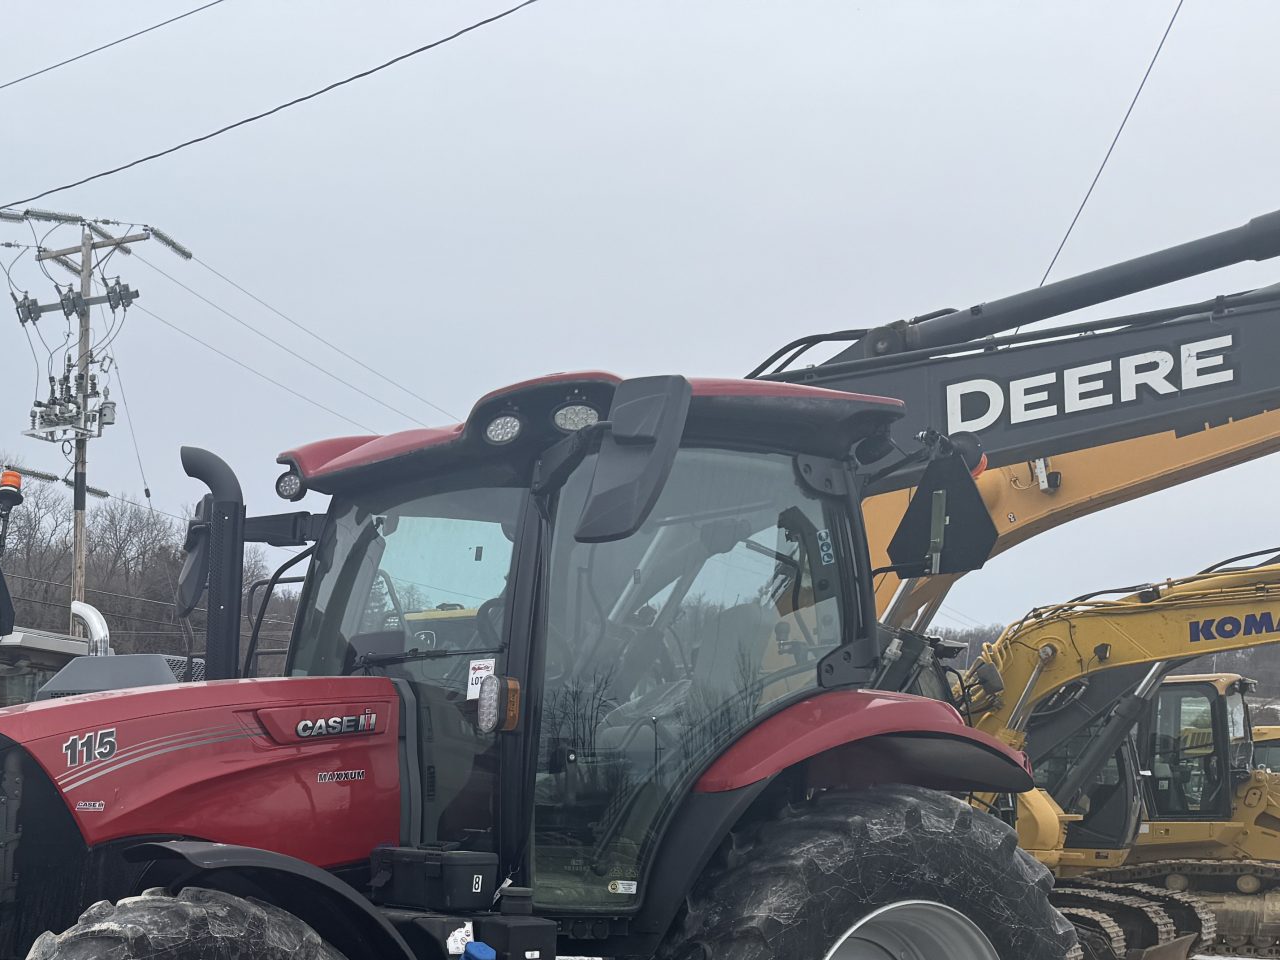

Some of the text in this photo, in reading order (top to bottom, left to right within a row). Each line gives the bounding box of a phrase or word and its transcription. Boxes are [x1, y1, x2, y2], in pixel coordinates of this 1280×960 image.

[946, 335, 1233, 436] DEERE
[1189, 611, 1280, 643] KOM
[296, 716, 356, 737] CASE
[62, 727, 118, 768] 115
[317, 769, 366, 783] MAXXUM
[473, 875, 481, 891] 8
